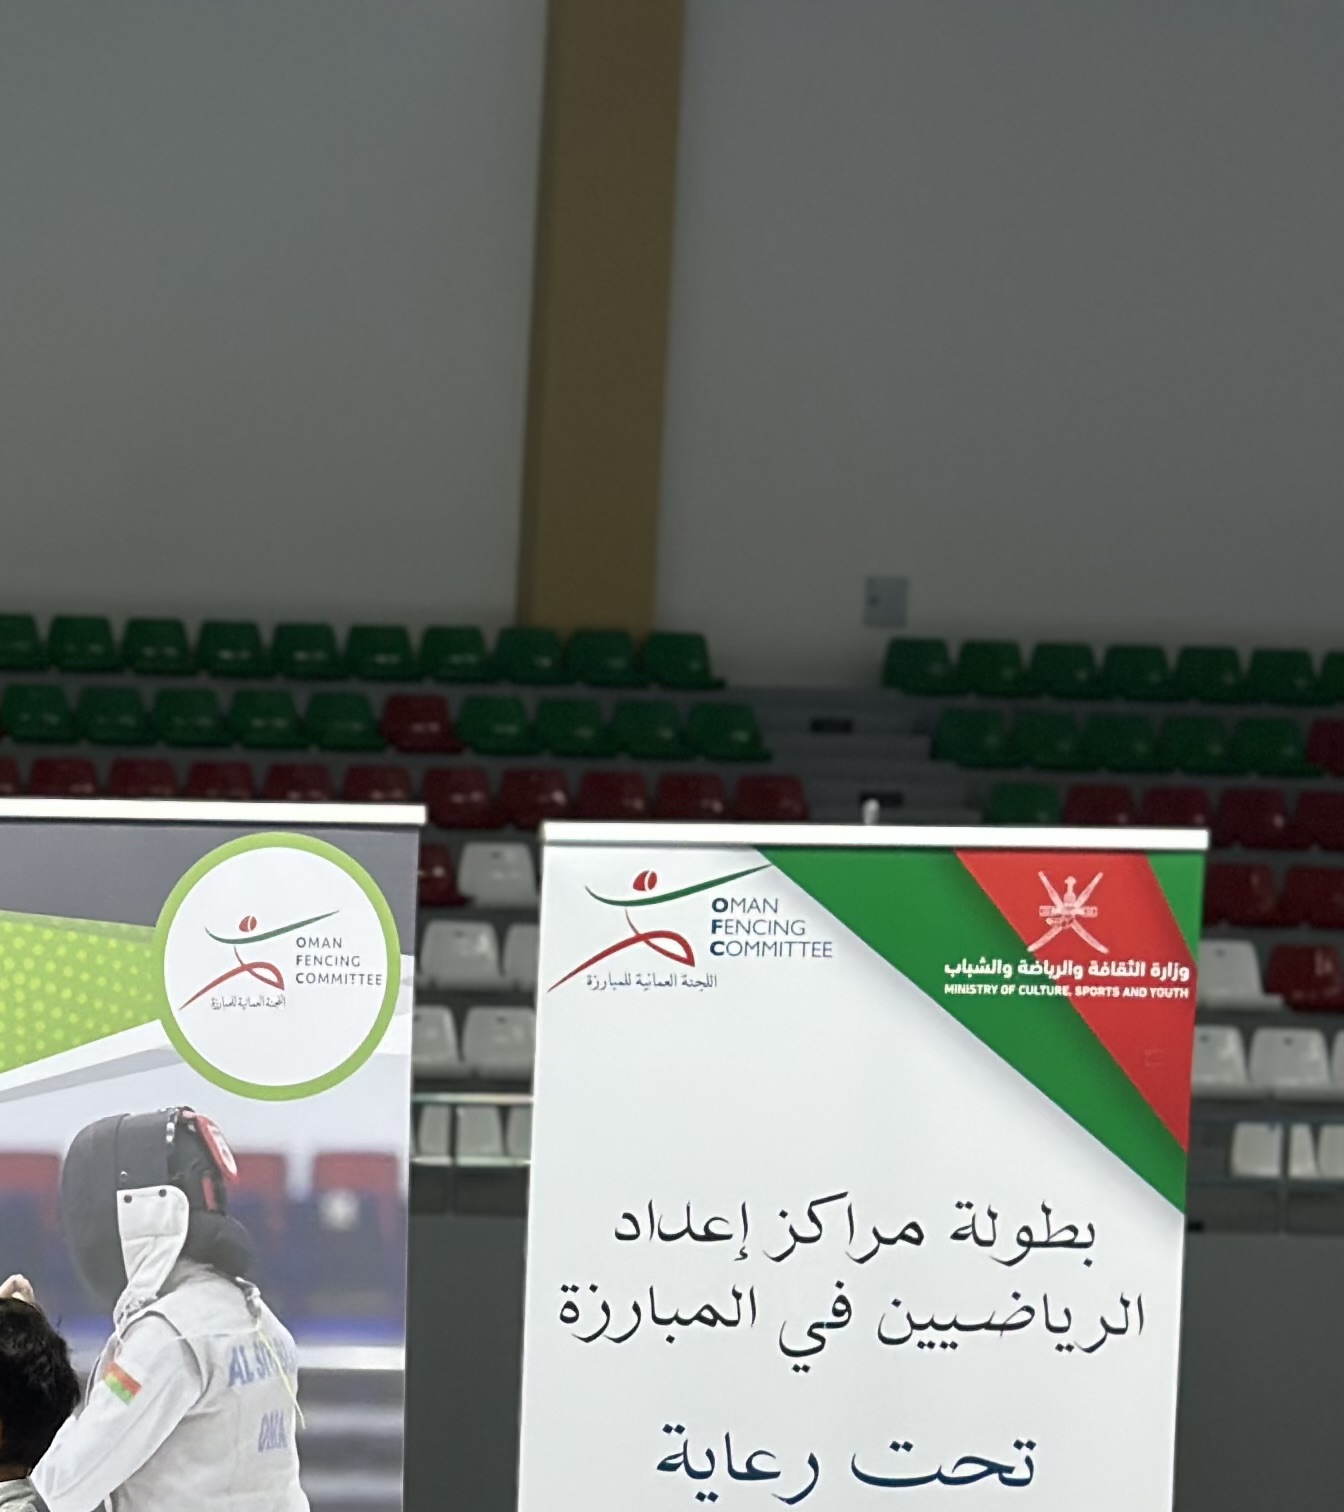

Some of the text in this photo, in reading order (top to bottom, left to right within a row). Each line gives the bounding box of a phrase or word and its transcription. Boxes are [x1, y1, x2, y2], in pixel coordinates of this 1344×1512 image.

[712, 898, 778, 913] OMAN
[711, 919, 805, 935] FENCING
[296, 937, 341, 948] OMAN
[710, 941, 832, 957] COMMITTEE
[296, 955, 360, 967] FENCING
[944, 957, 1189, 982] وزارة الثقافة والرياضة والشباب
[296, 973, 382, 985] COMMITTEE
[587, 973, 717, 991] اللجنة العمانية للمبارزة
[945, 984, 998, 994] MINISTRY
[1001, 984, 1016, 995] OF
[1075, 986, 1120, 997] SPORTS
[1123, 987, 1147, 997] AND
[1150, 987, 1189, 998] YOUTH
[615, 1192, 1095, 1267] بطولة مراكز إعداد
[560, 1281, 1143, 1373] الرياضيين في المبارزة
[657, 1424, 1036, 1505] تحت رعاية
